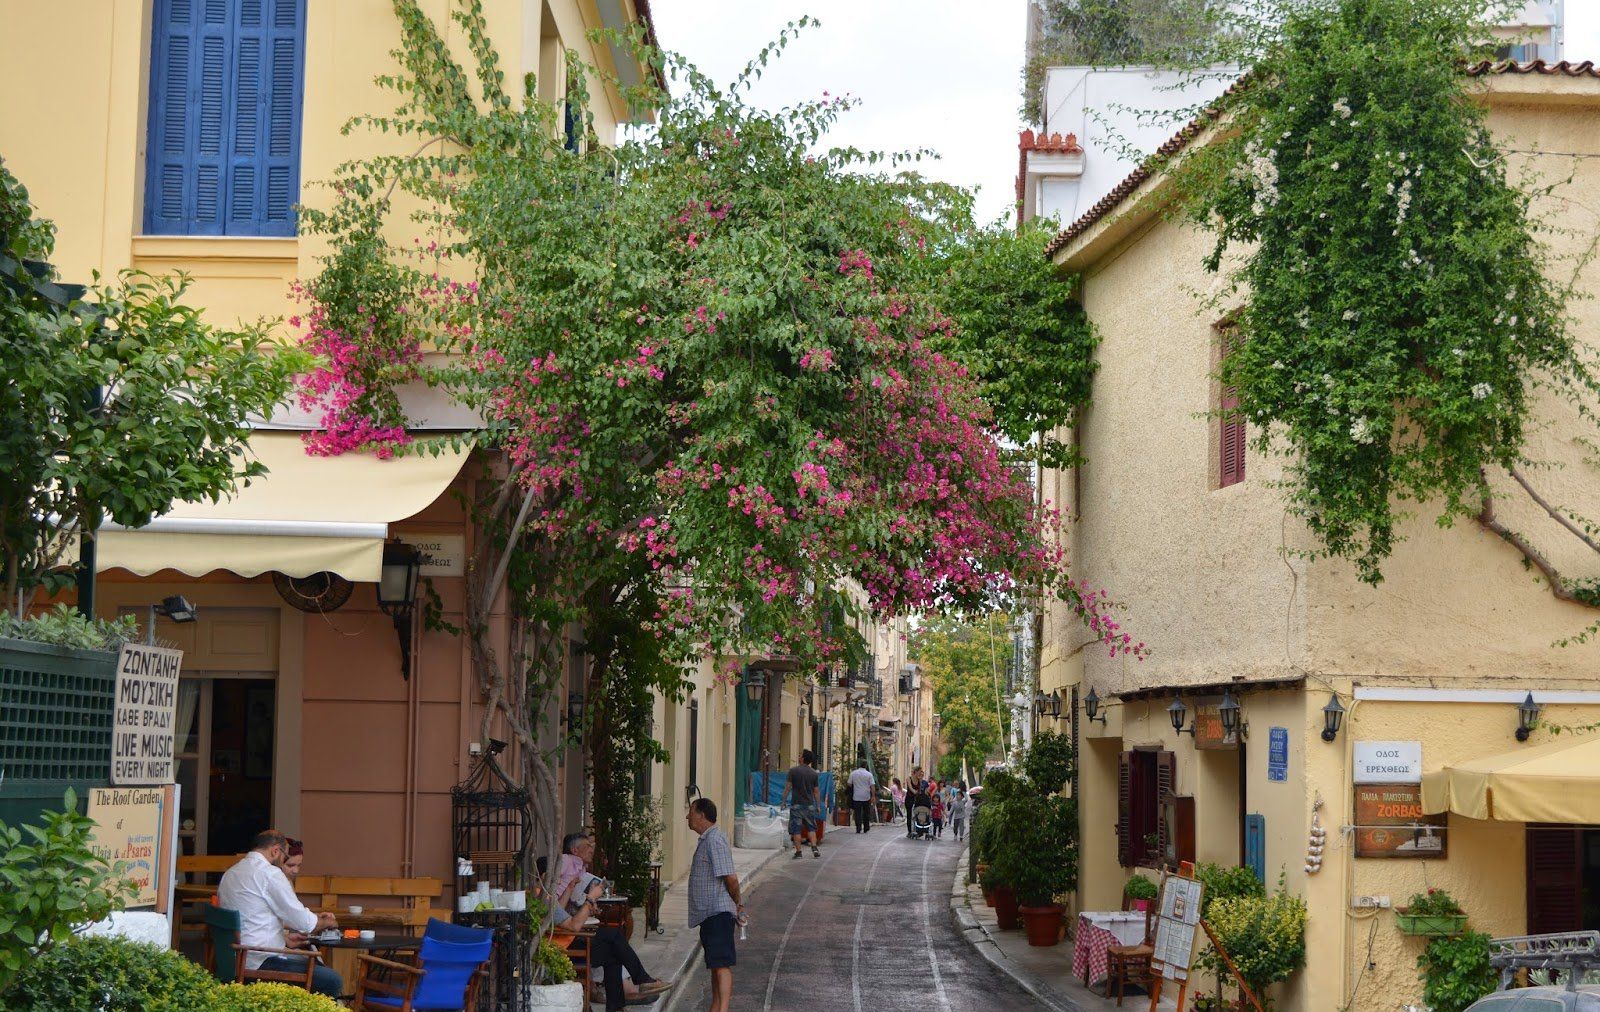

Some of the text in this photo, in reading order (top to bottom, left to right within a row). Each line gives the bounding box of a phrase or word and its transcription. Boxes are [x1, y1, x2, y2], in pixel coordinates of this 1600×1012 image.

[416, 542, 442, 551] ΟΔΟΣ
[123, 649, 179, 679] ΖΩΝΤΑΝΗ
[120, 678, 174, 707] ΜΟΥΣΙΚΗ
[116, 708, 171, 728] ΚΑΘΕ ΒΡΑΔΥ
[116, 733, 173, 758] LIVE MUSIC
[1375, 750, 1400, 758] ΟΔΟΣ
[115, 761, 171, 778] EVERY NIGHT
[1366, 765, 1410, 773] ΕΡΕΧΘΕΩΣ
[96, 789, 160, 806] The Roof Garden
[116, 818, 124, 830] of
[127, 843, 152, 859] Psaras
